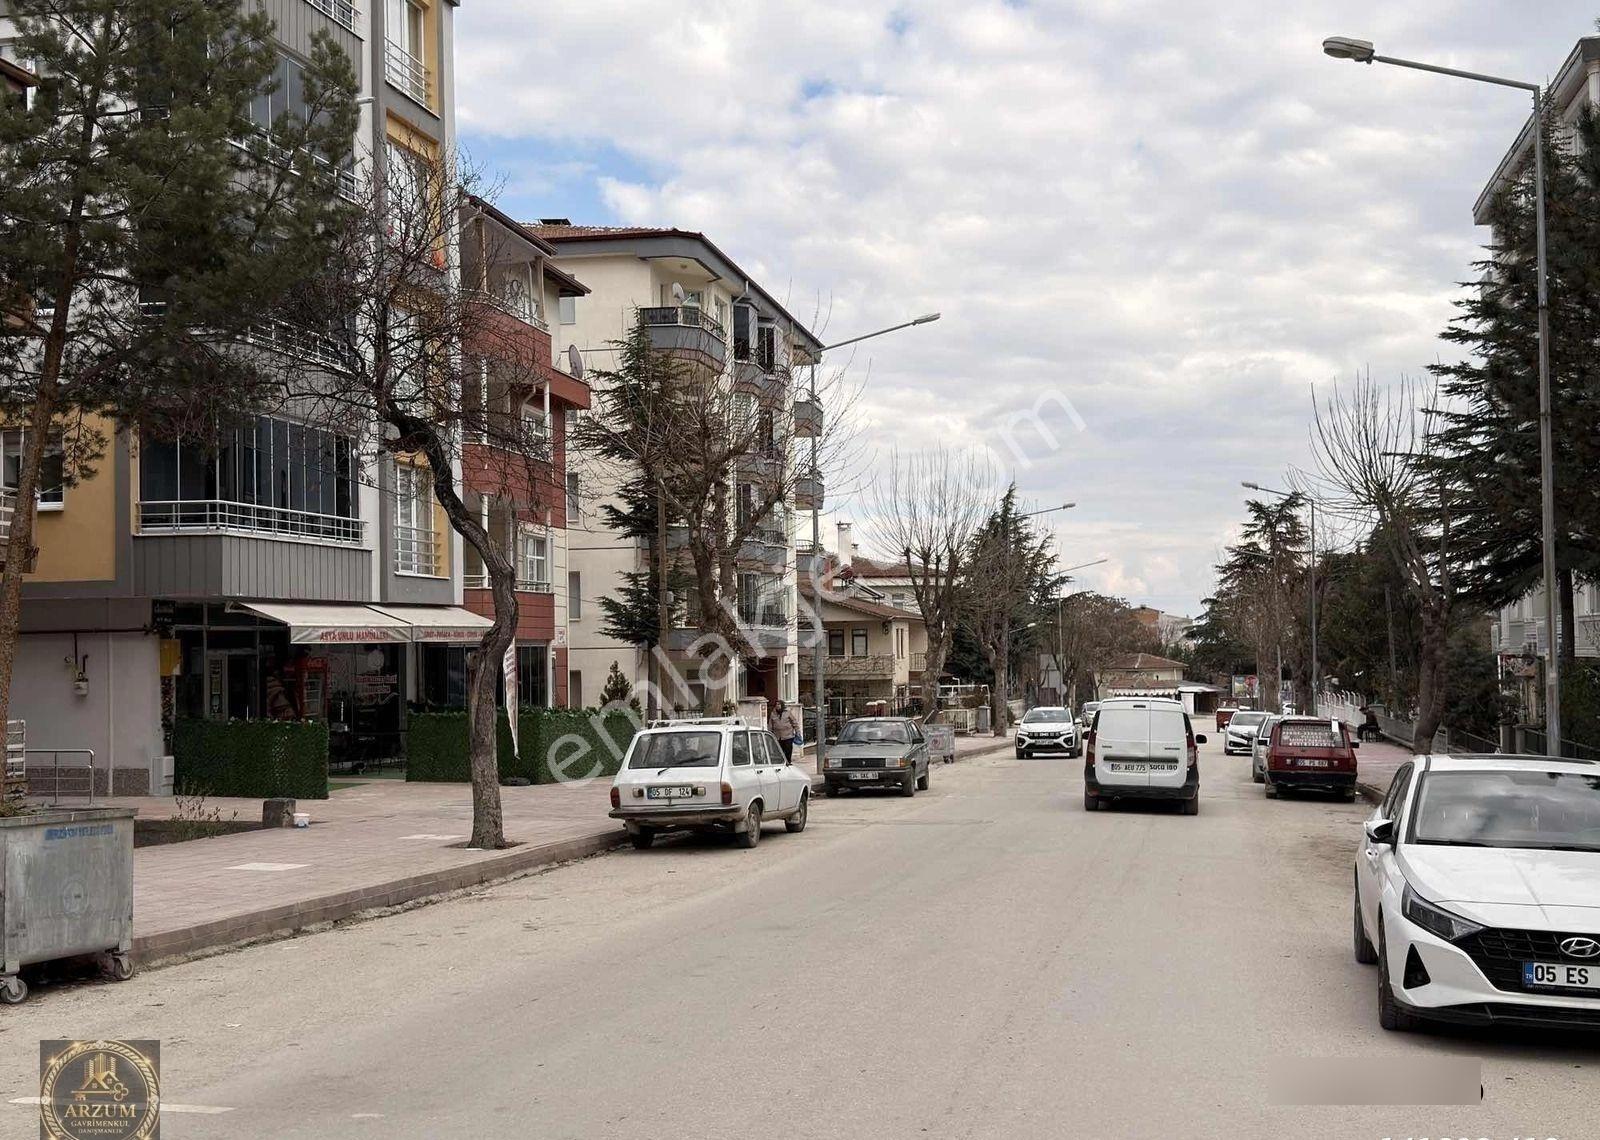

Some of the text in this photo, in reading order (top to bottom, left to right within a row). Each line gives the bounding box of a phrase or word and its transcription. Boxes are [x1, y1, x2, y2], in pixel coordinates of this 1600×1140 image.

[679, 787, 690, 796] 124
[1535, 965, 1556, 982] 05
[1566, 967, 1589, 985] ES
